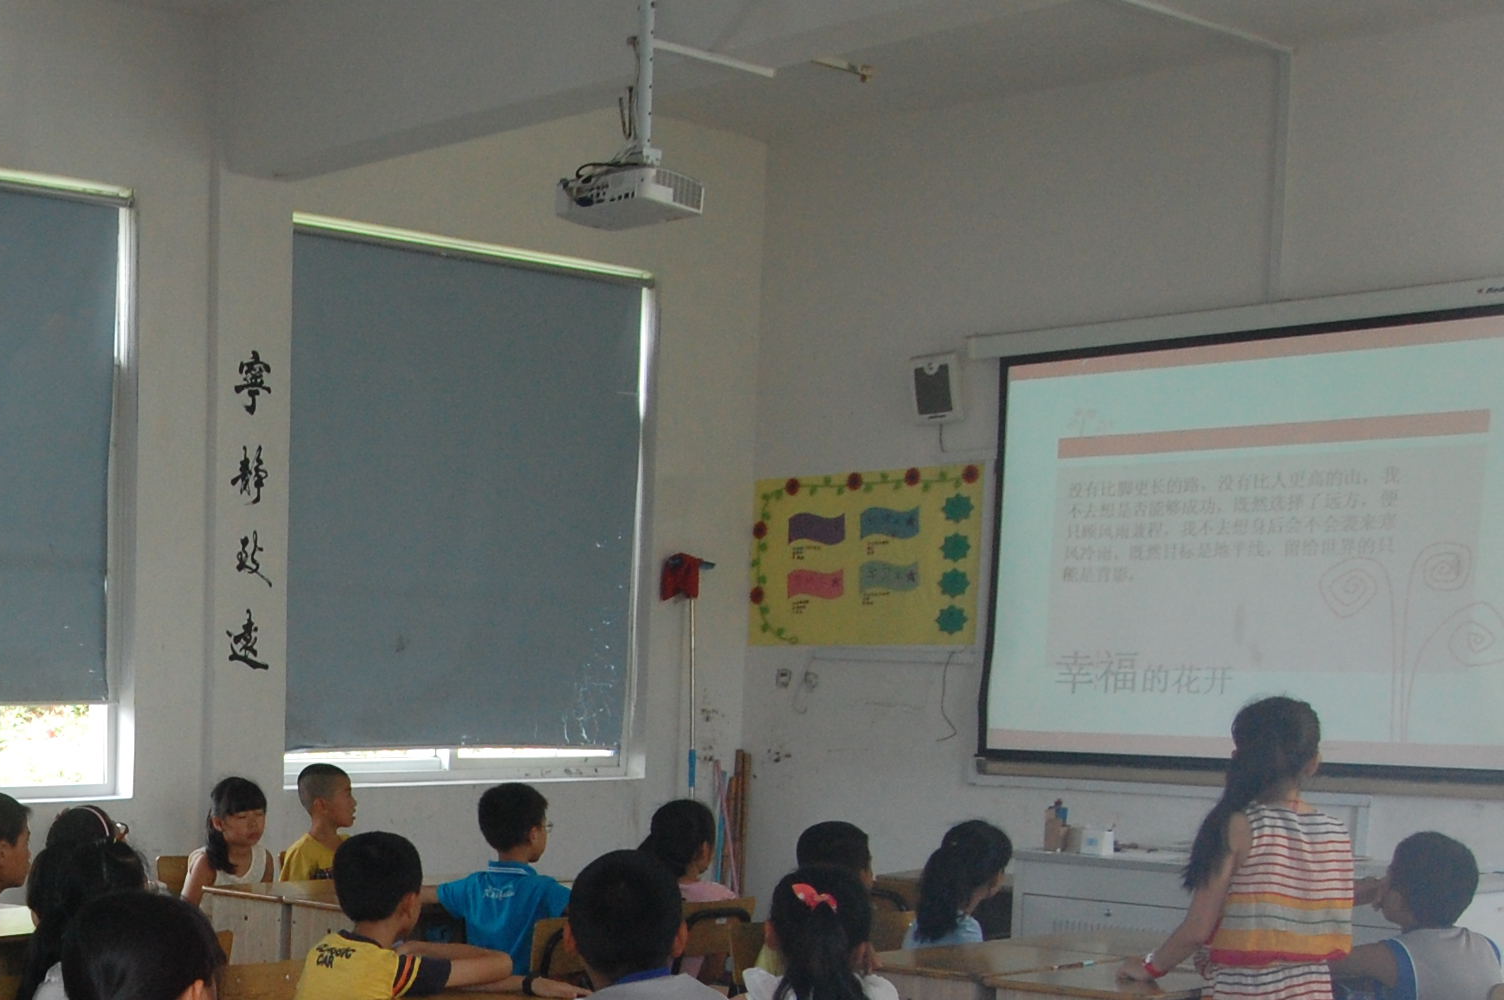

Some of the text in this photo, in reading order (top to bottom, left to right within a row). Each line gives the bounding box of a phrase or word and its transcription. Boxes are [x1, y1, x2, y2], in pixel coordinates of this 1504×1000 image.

[1055, 650, 1233, 695] 幸福的花开
